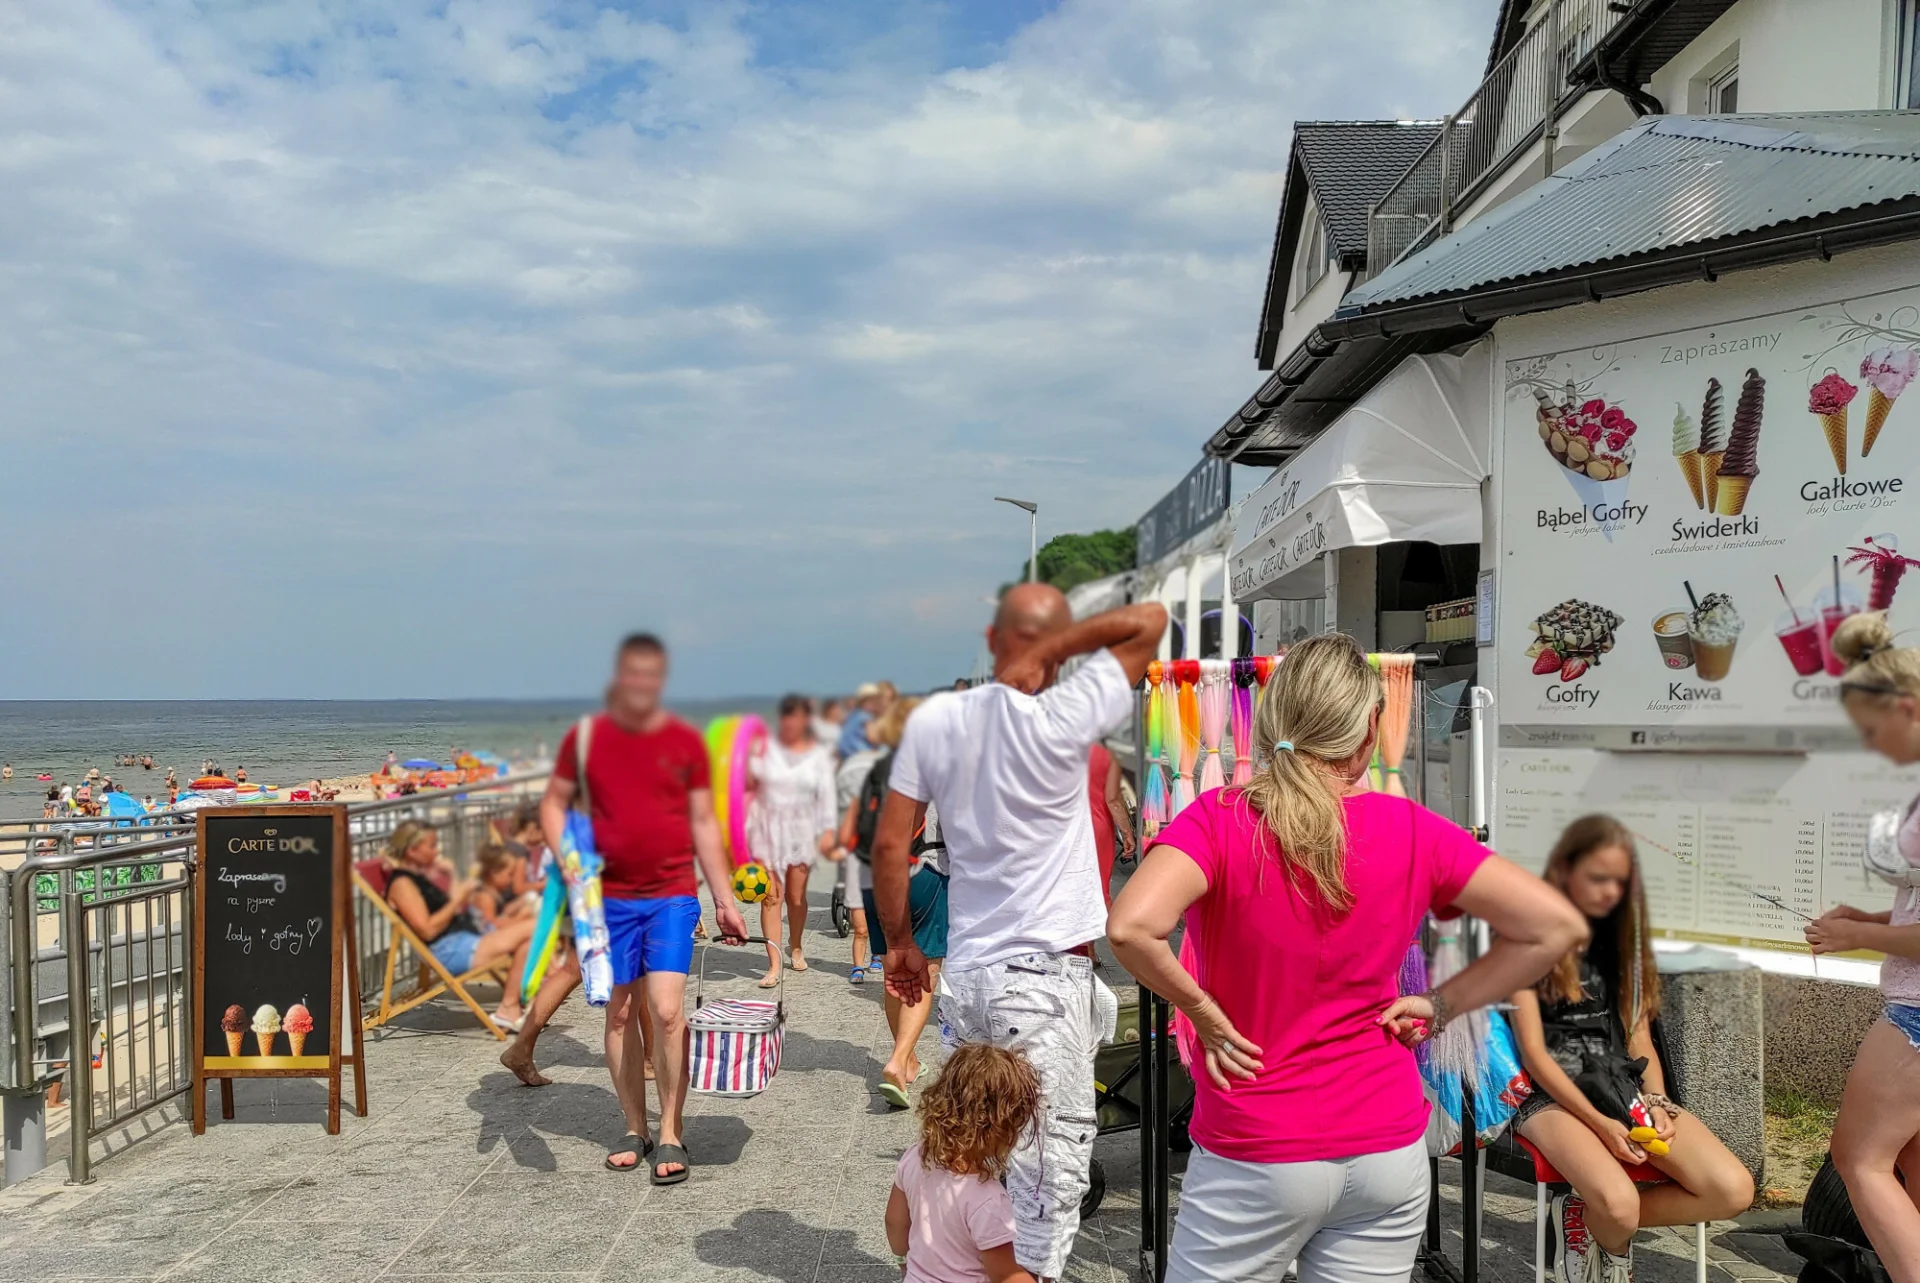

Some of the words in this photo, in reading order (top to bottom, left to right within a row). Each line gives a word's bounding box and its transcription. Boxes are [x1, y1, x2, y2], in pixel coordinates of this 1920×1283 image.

[1660, 332, 1782, 365] Zapraszamy
[1800, 476, 1903, 502] Gałkowe
[1537, 503, 1587, 532] Bąbel
[1592, 499, 1649, 525] Gofry
[1806, 501, 1829, 518] lody
[1671, 514, 1760, 541] Świderki
[1546, 683, 1600, 709] Gofry
[1668, 682, 1722, 701] Kawa
[228, 837, 275, 854] CARTE
[225, 922, 252, 954] lody
